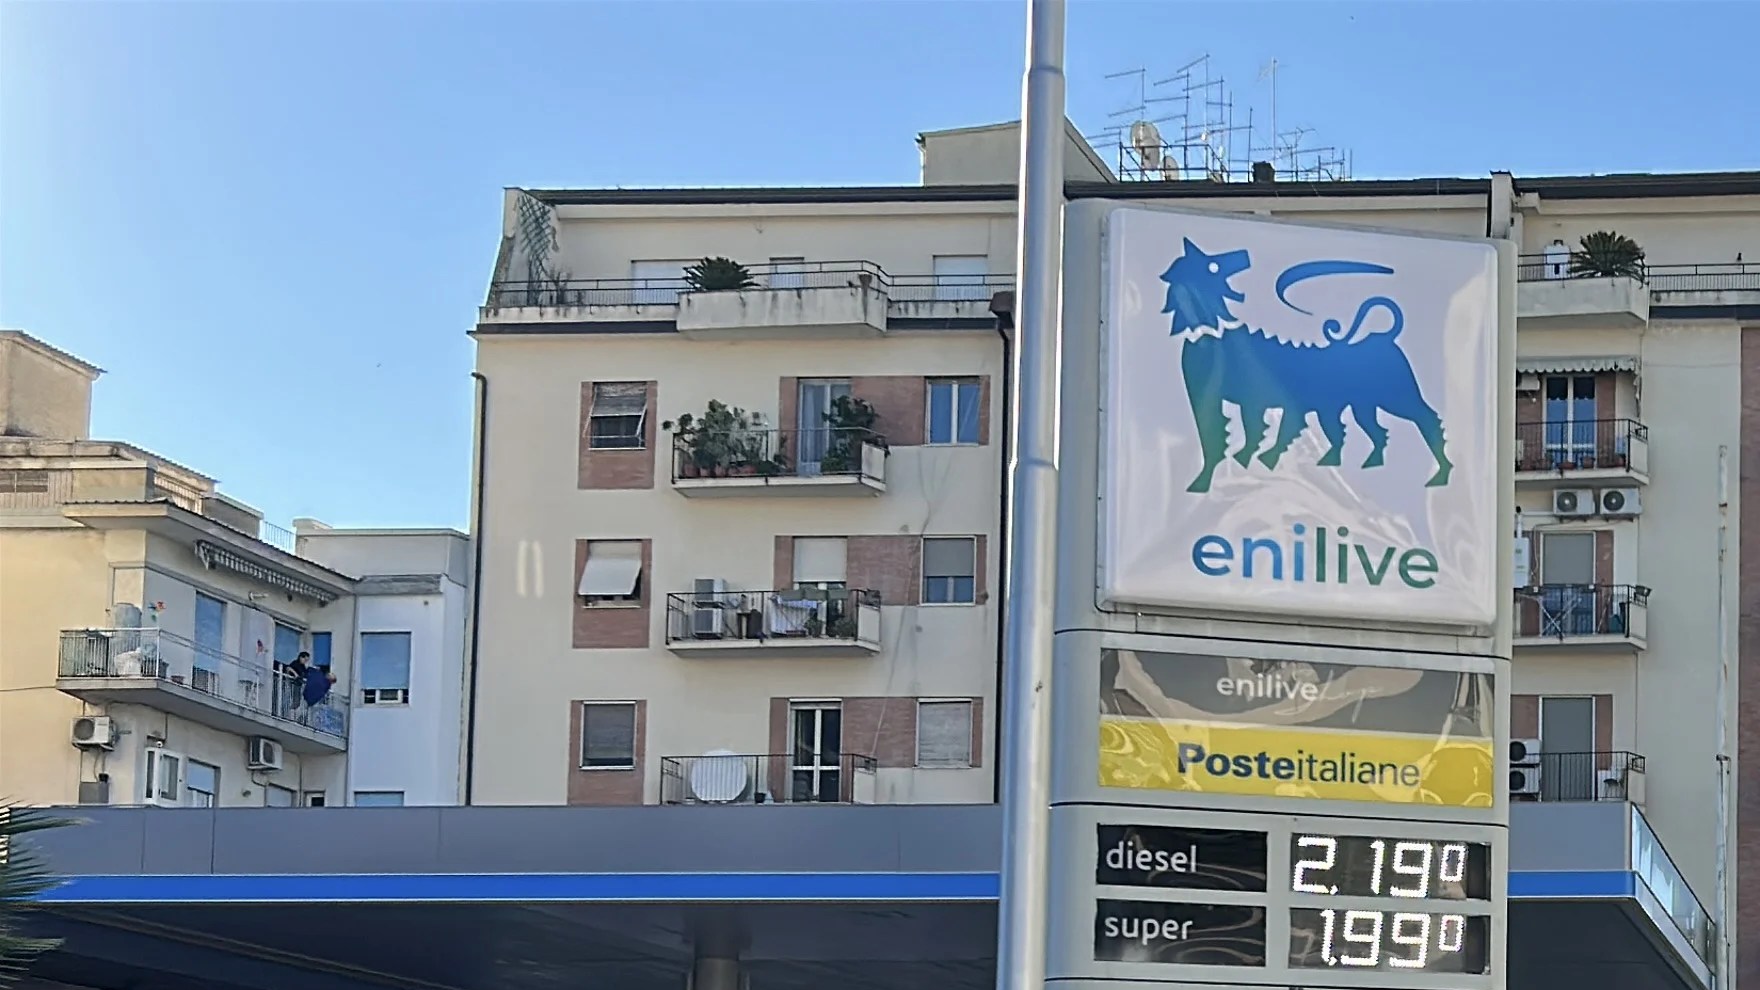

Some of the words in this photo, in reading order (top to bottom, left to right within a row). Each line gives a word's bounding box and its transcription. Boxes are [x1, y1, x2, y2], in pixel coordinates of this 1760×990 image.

[1192, 523, 1439, 589] enilive
[1216, 671, 1319, 701] enilive
[1106, 842, 1197, 873] diesel
[1104, 915, 1194, 945] super
